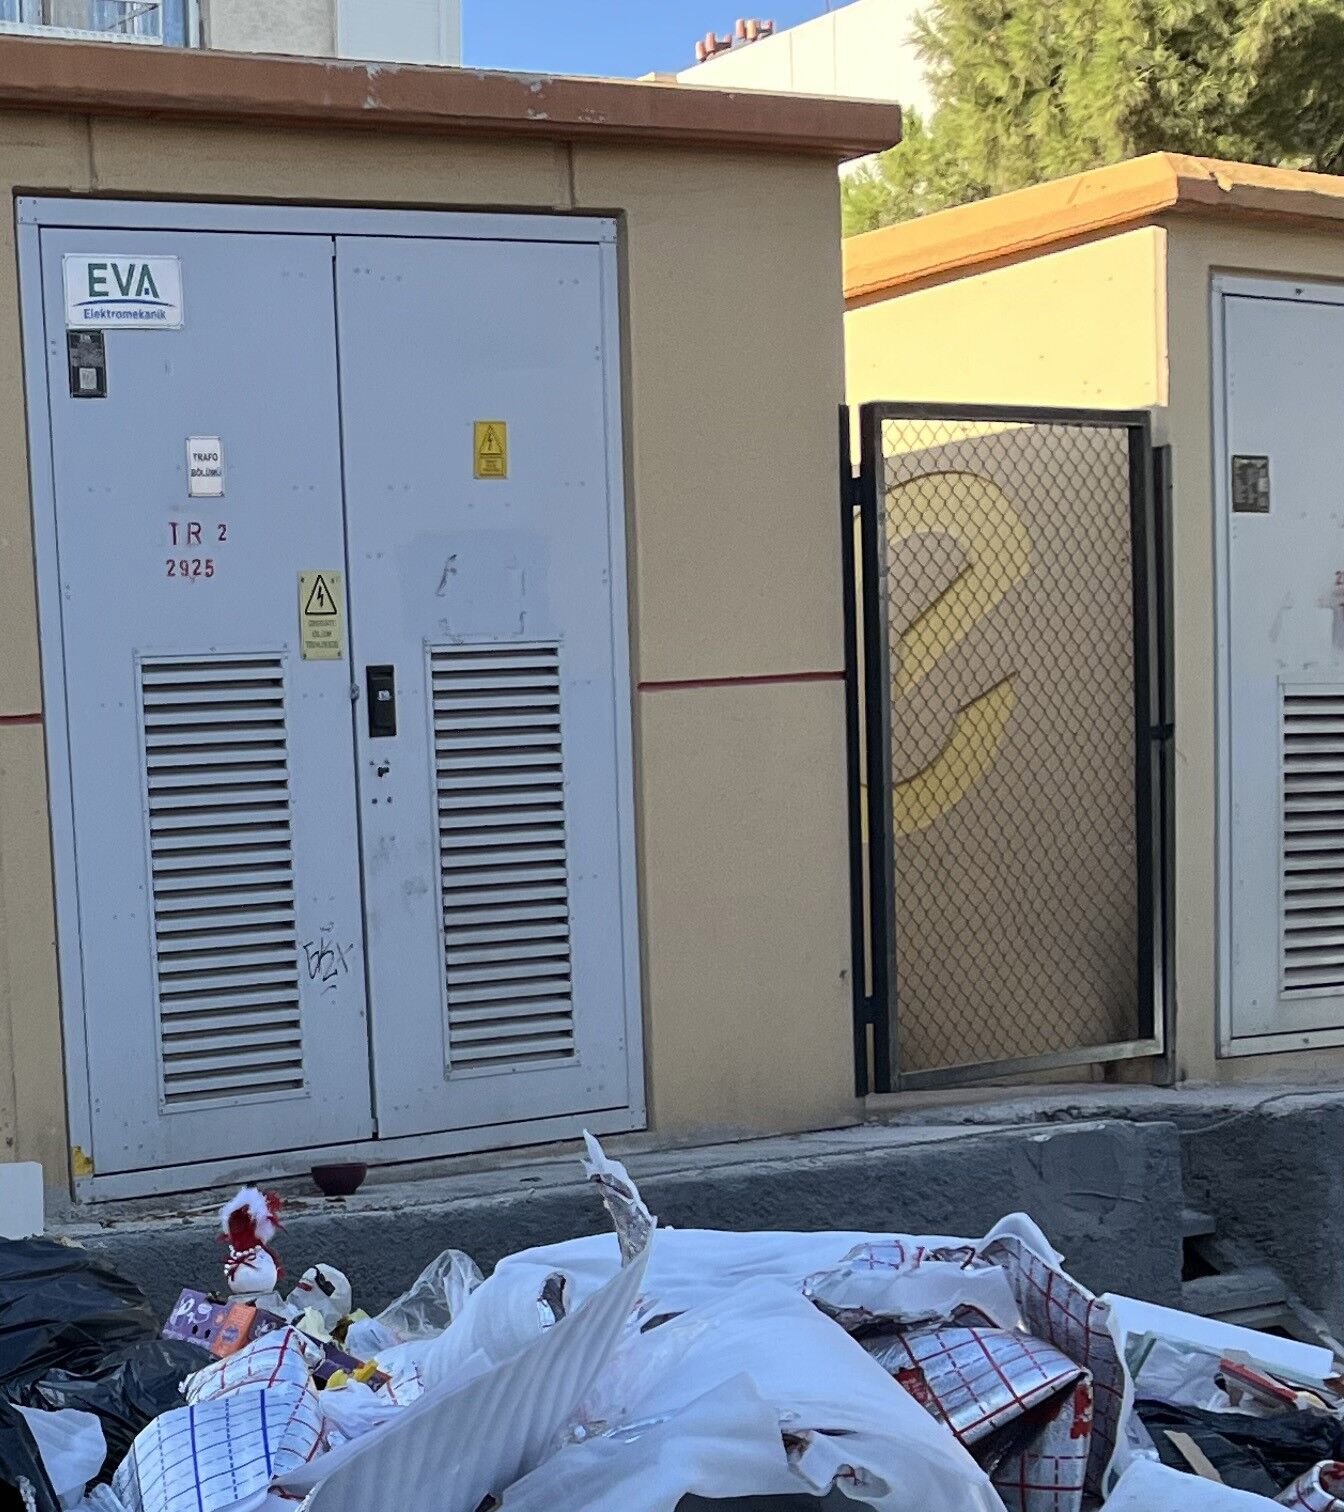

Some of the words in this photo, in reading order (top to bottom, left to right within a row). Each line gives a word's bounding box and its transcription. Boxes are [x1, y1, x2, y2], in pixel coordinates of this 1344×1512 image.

[88, 263, 160, 298] EVA
[84, 308, 166, 320] Elektromekanik
[192, 452, 218, 462] TRAFO
[217, 524, 228, 542] 2
[165, 558, 215, 578] 2925
